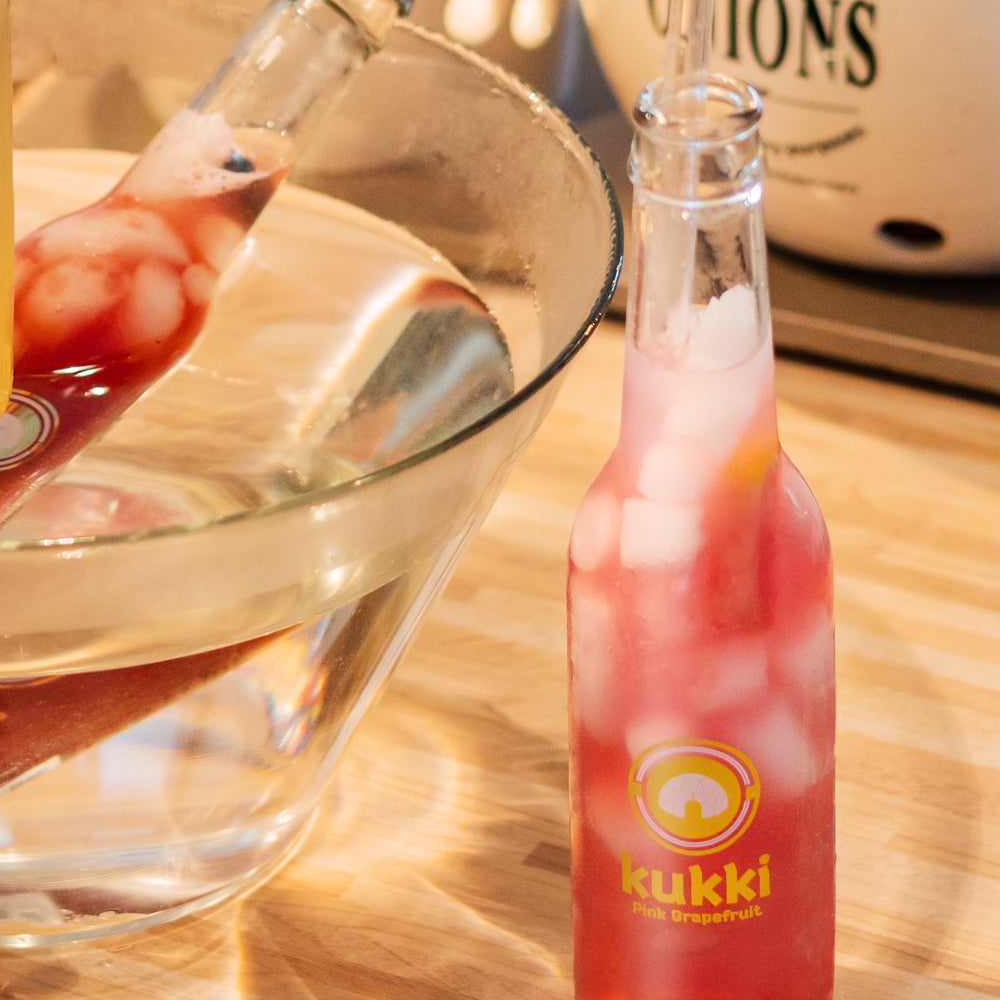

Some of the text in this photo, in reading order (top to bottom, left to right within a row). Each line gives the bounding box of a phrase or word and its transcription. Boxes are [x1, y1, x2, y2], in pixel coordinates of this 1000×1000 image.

[620, 852, 771, 907] kukki
[632, 901, 763, 926] Pink Grapefruit
